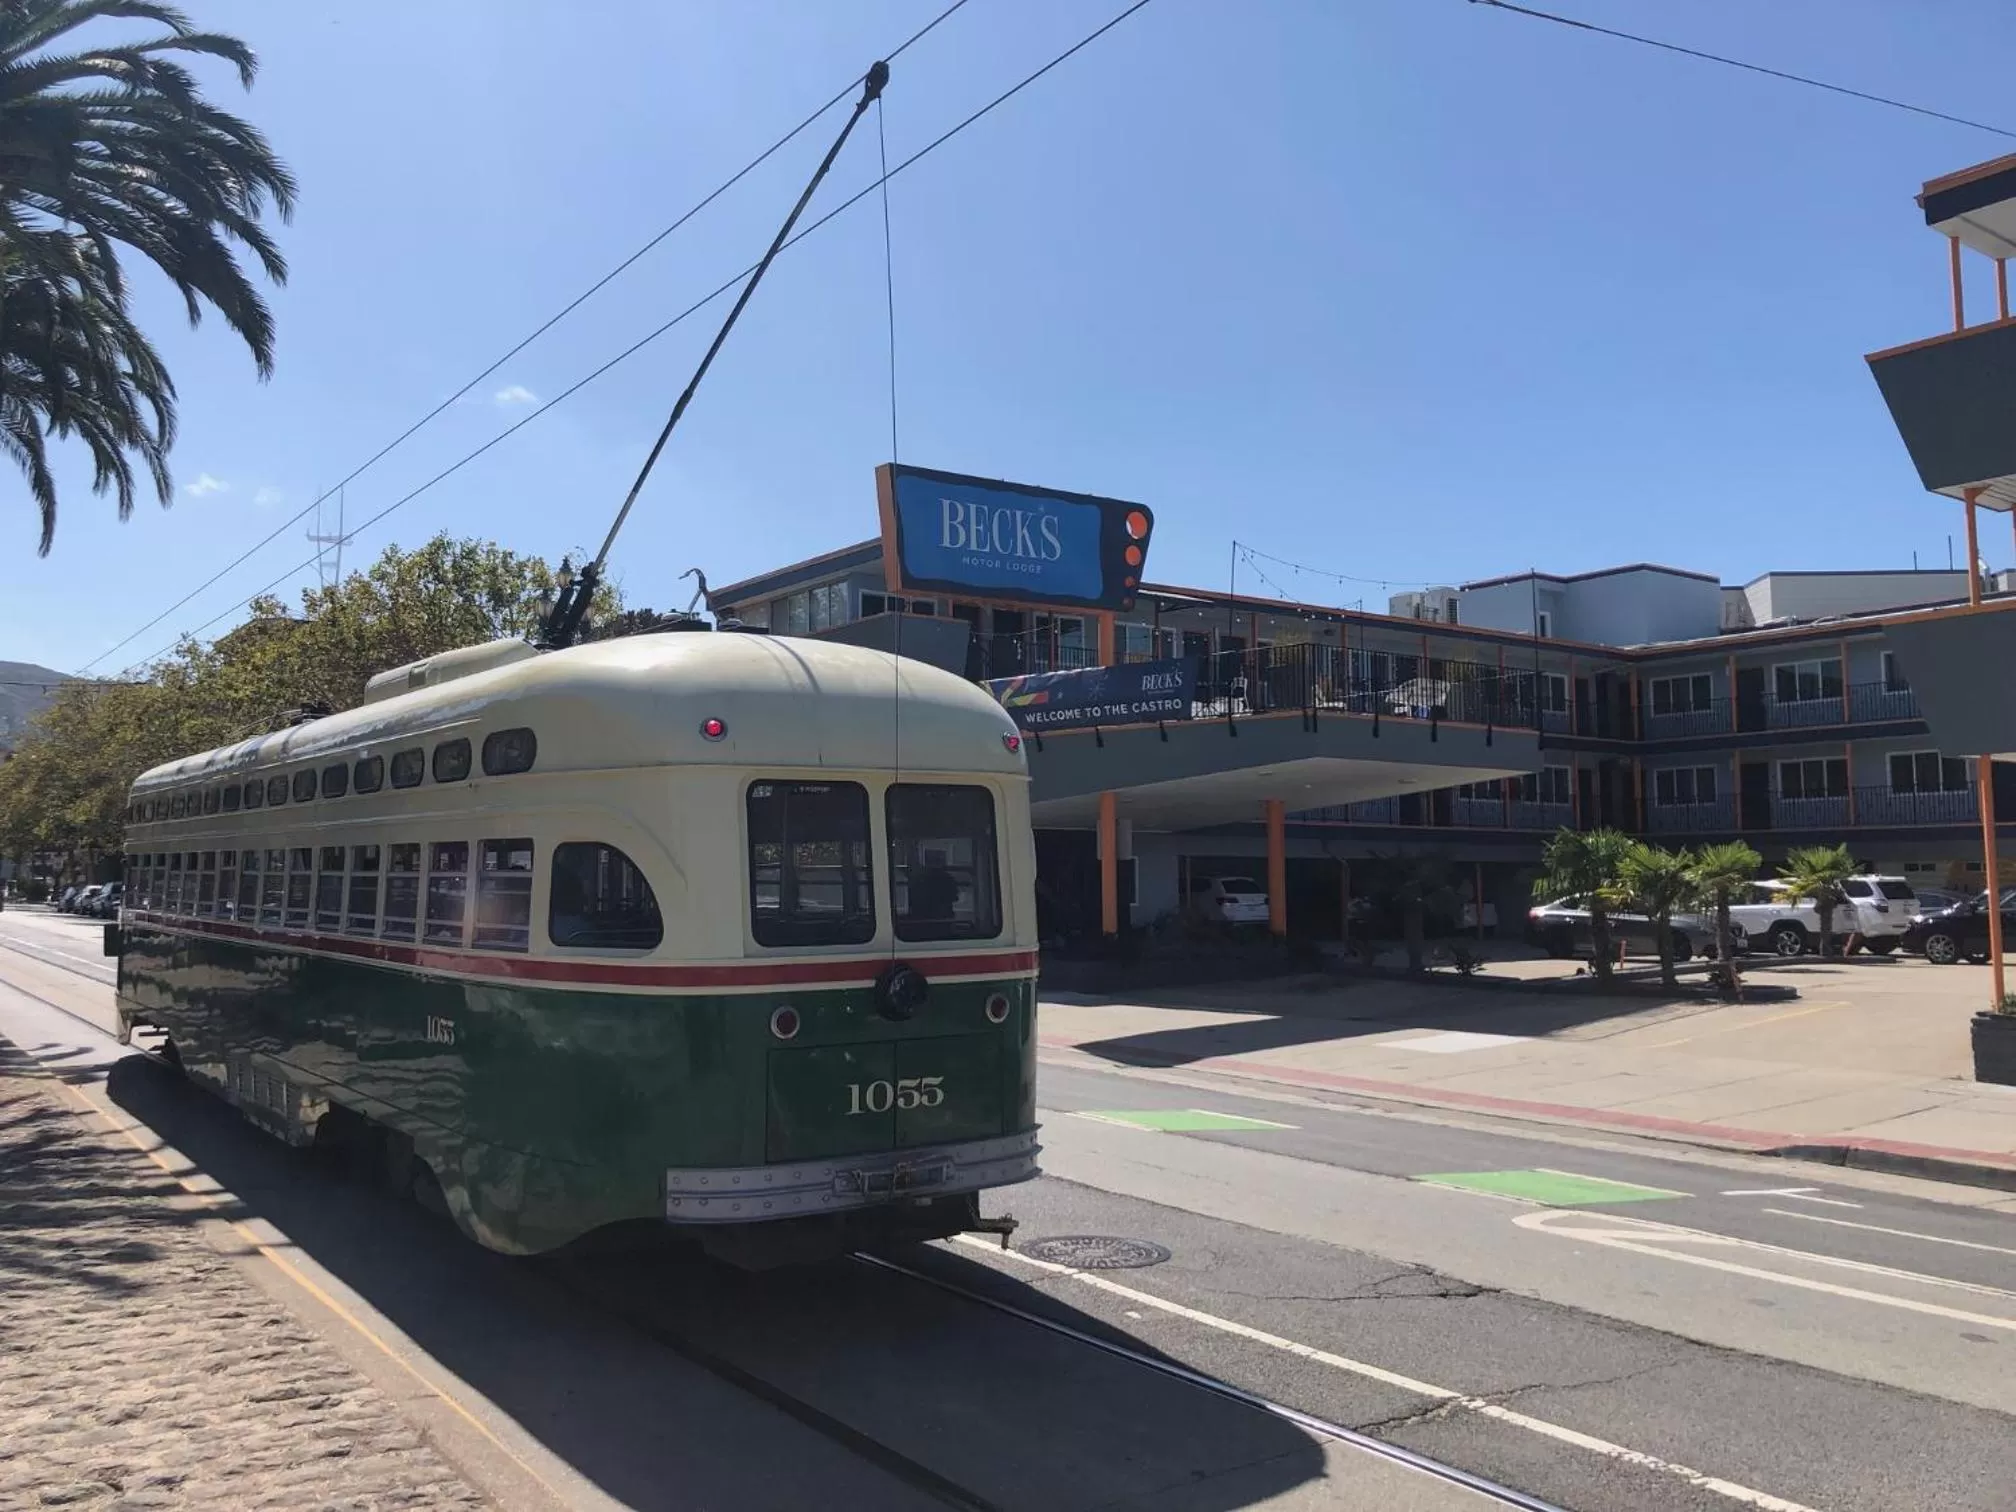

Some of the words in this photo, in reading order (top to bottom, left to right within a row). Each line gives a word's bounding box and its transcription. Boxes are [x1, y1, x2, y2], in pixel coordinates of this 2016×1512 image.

[938, 498, 1061, 561] BECK'S
[962, 556, 1000, 569] MOTOR
[1142, 669, 1184, 690] BECK'S
[1025, 708, 1082, 724] WELCOME
[1086, 706, 1101, 718] TO
[1104, 703, 1129, 717] THE
[1132, 698, 1183, 714] CASTRO
[427, 1015, 455, 1046] 1055
[842, 1076, 945, 1116] 1055
